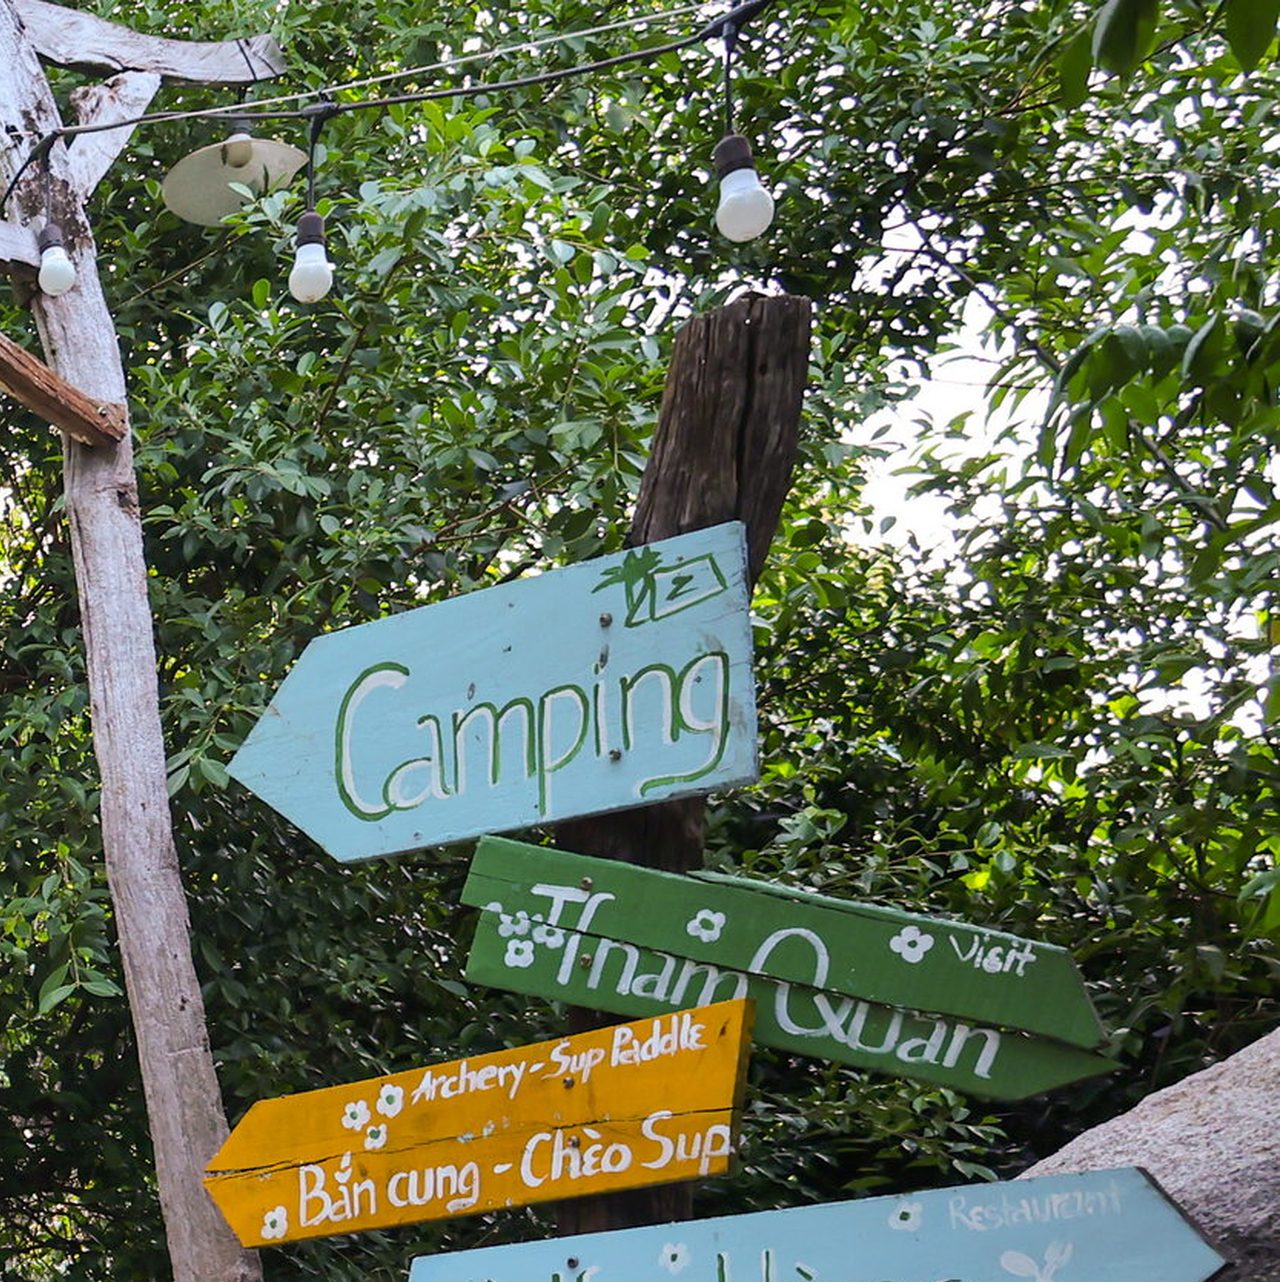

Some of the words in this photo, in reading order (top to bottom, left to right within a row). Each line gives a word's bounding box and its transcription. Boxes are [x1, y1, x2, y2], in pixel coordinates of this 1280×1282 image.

[333, 649, 732, 821] Camping
[529, 881, 748, 1008] Tham
[749, 926, 1003, 1080] Quan
[949, 933, 1037, 977] Visit
[410, 1060, 527, 1100] Archery
[541, 1039, 606, 1084] Sup
[610, 1012, 708, 1068] Paddle
[386, 1160, 480, 1214] cung
[519, 1126, 634, 1189] Chèo
[640, 1109, 732, 1177] Sup
[948, 1178, 1123, 1233] Restaurant
